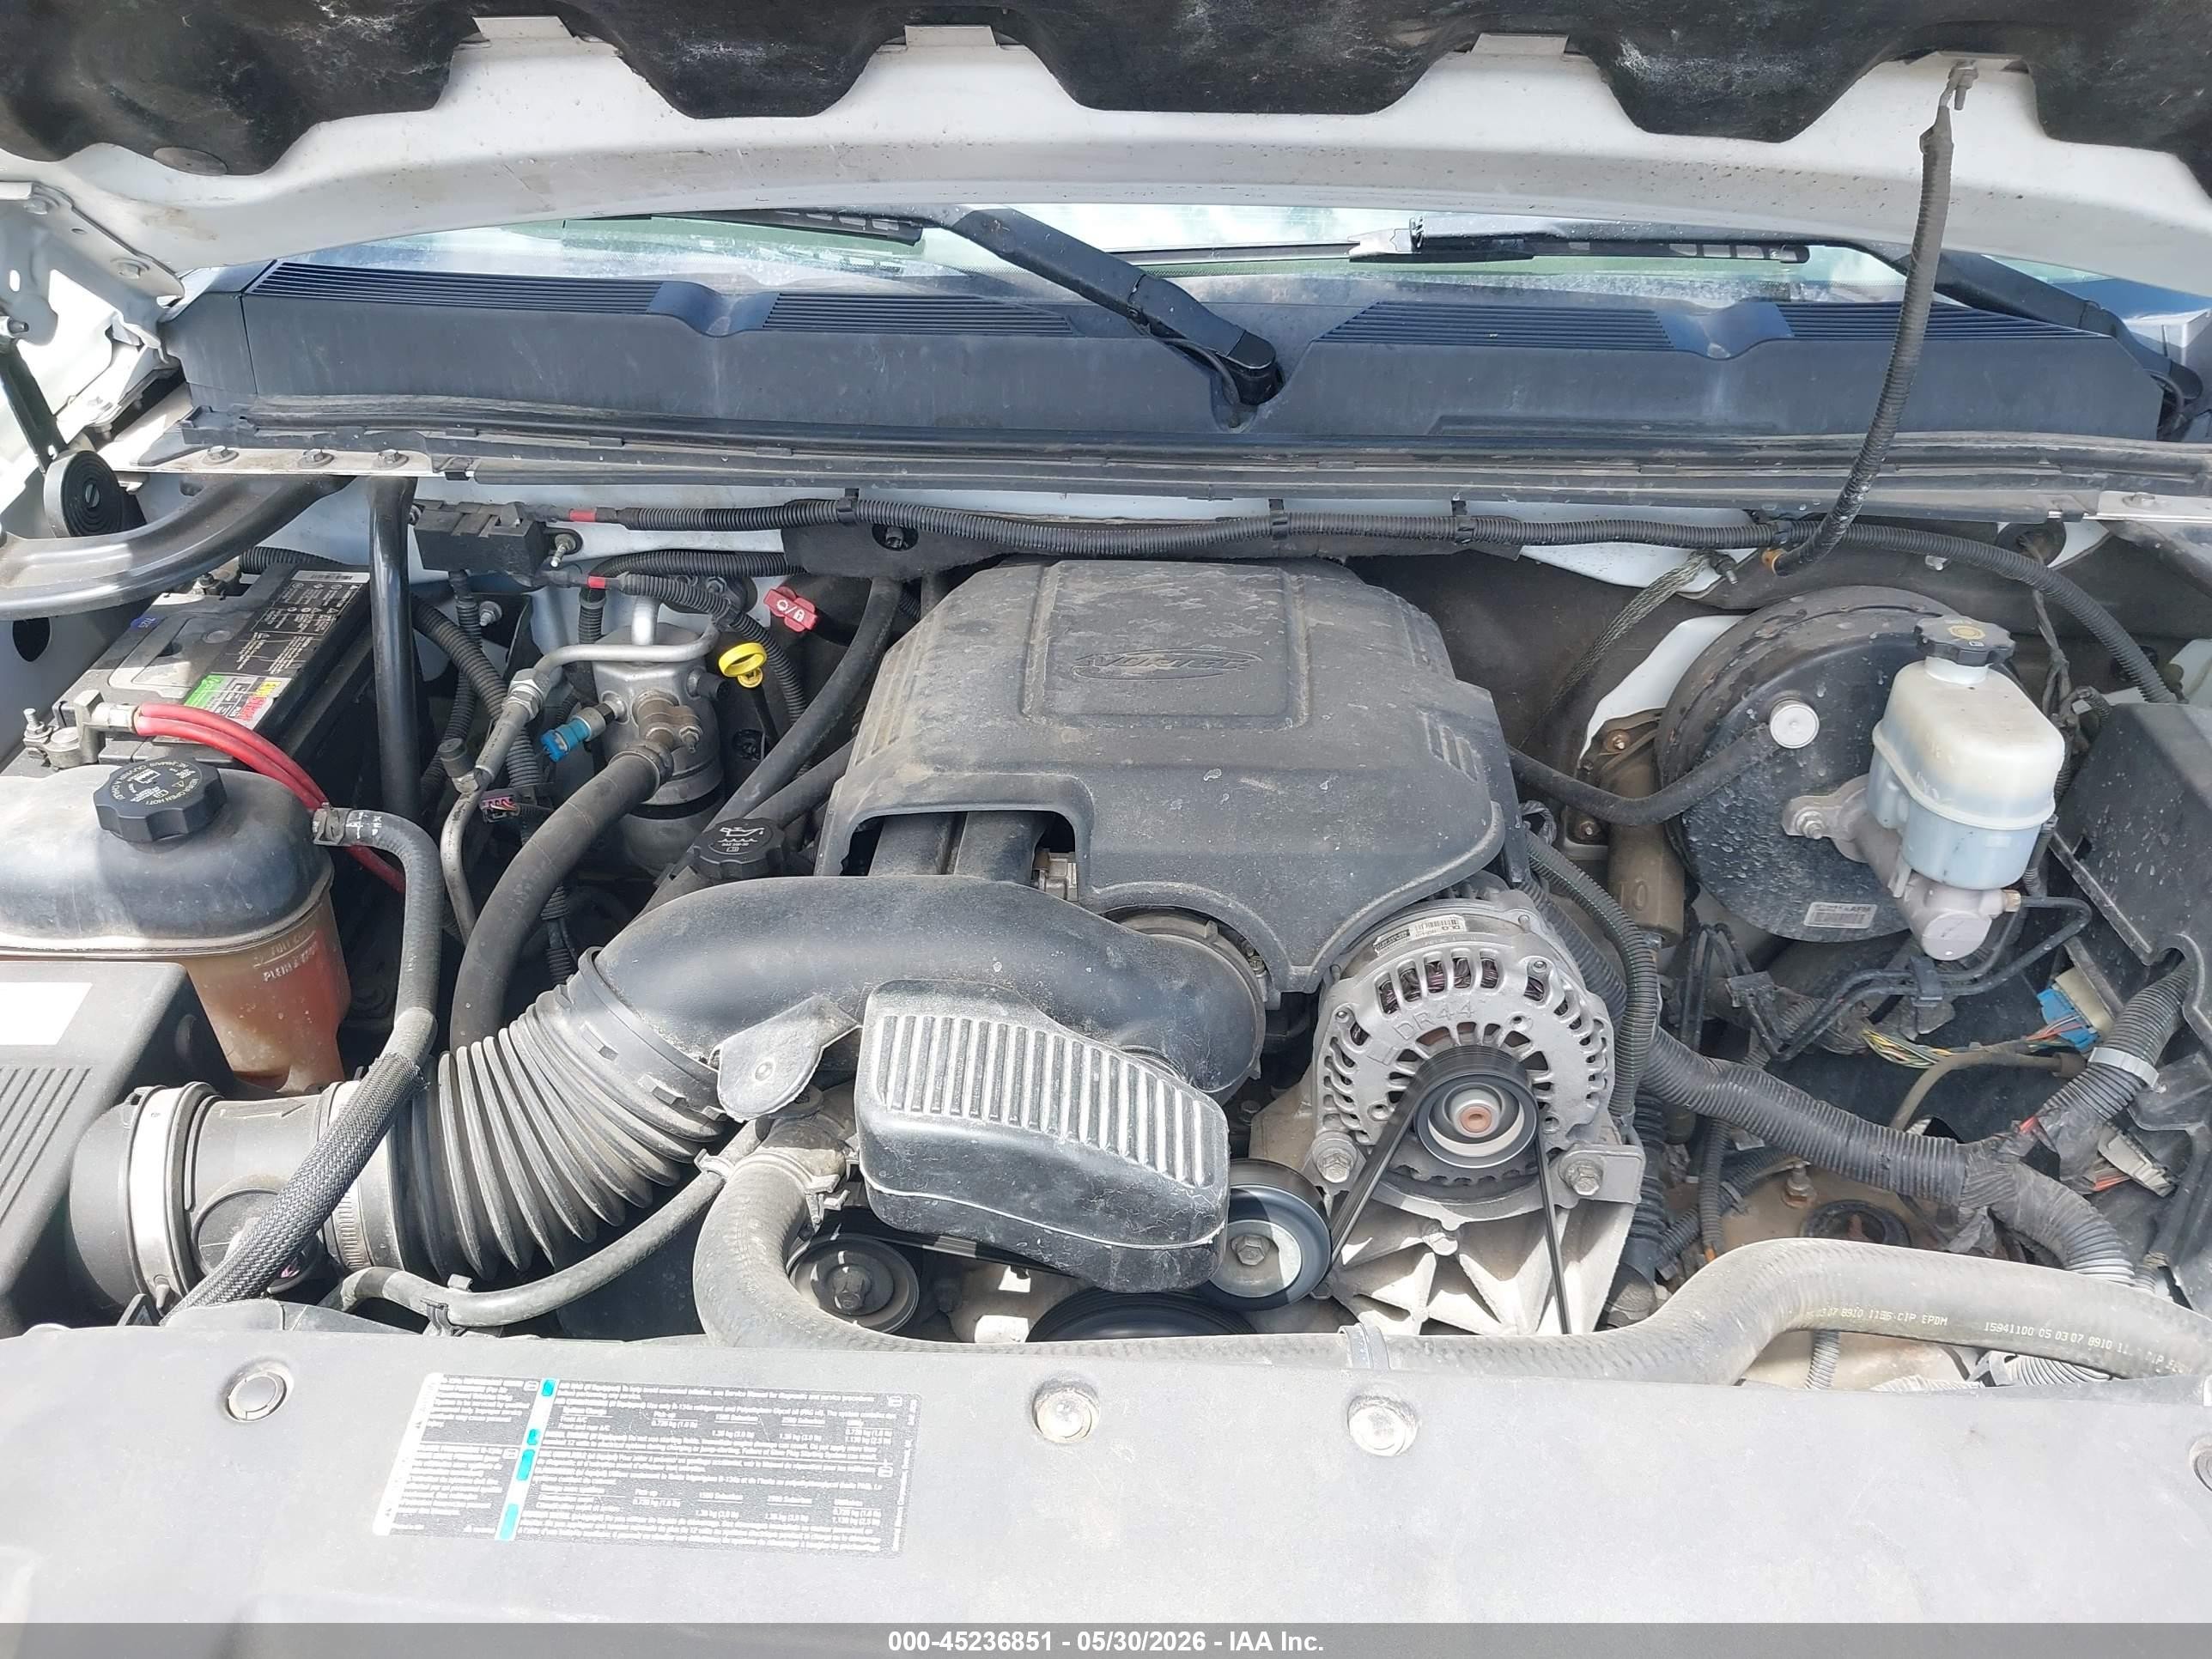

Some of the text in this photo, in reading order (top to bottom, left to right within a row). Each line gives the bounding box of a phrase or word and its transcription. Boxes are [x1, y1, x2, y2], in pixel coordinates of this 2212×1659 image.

[1392, 1000, 1475, 1042] DR44
[1922, 1314, 1949, 1327] EPDM
[1984, 1322, 2035, 1337] 15941100
[2039, 1328, 2052, 1340] 05
[2054, 1330, 2069, 1342] 03
[2070, 1332, 2085, 1345] 07
